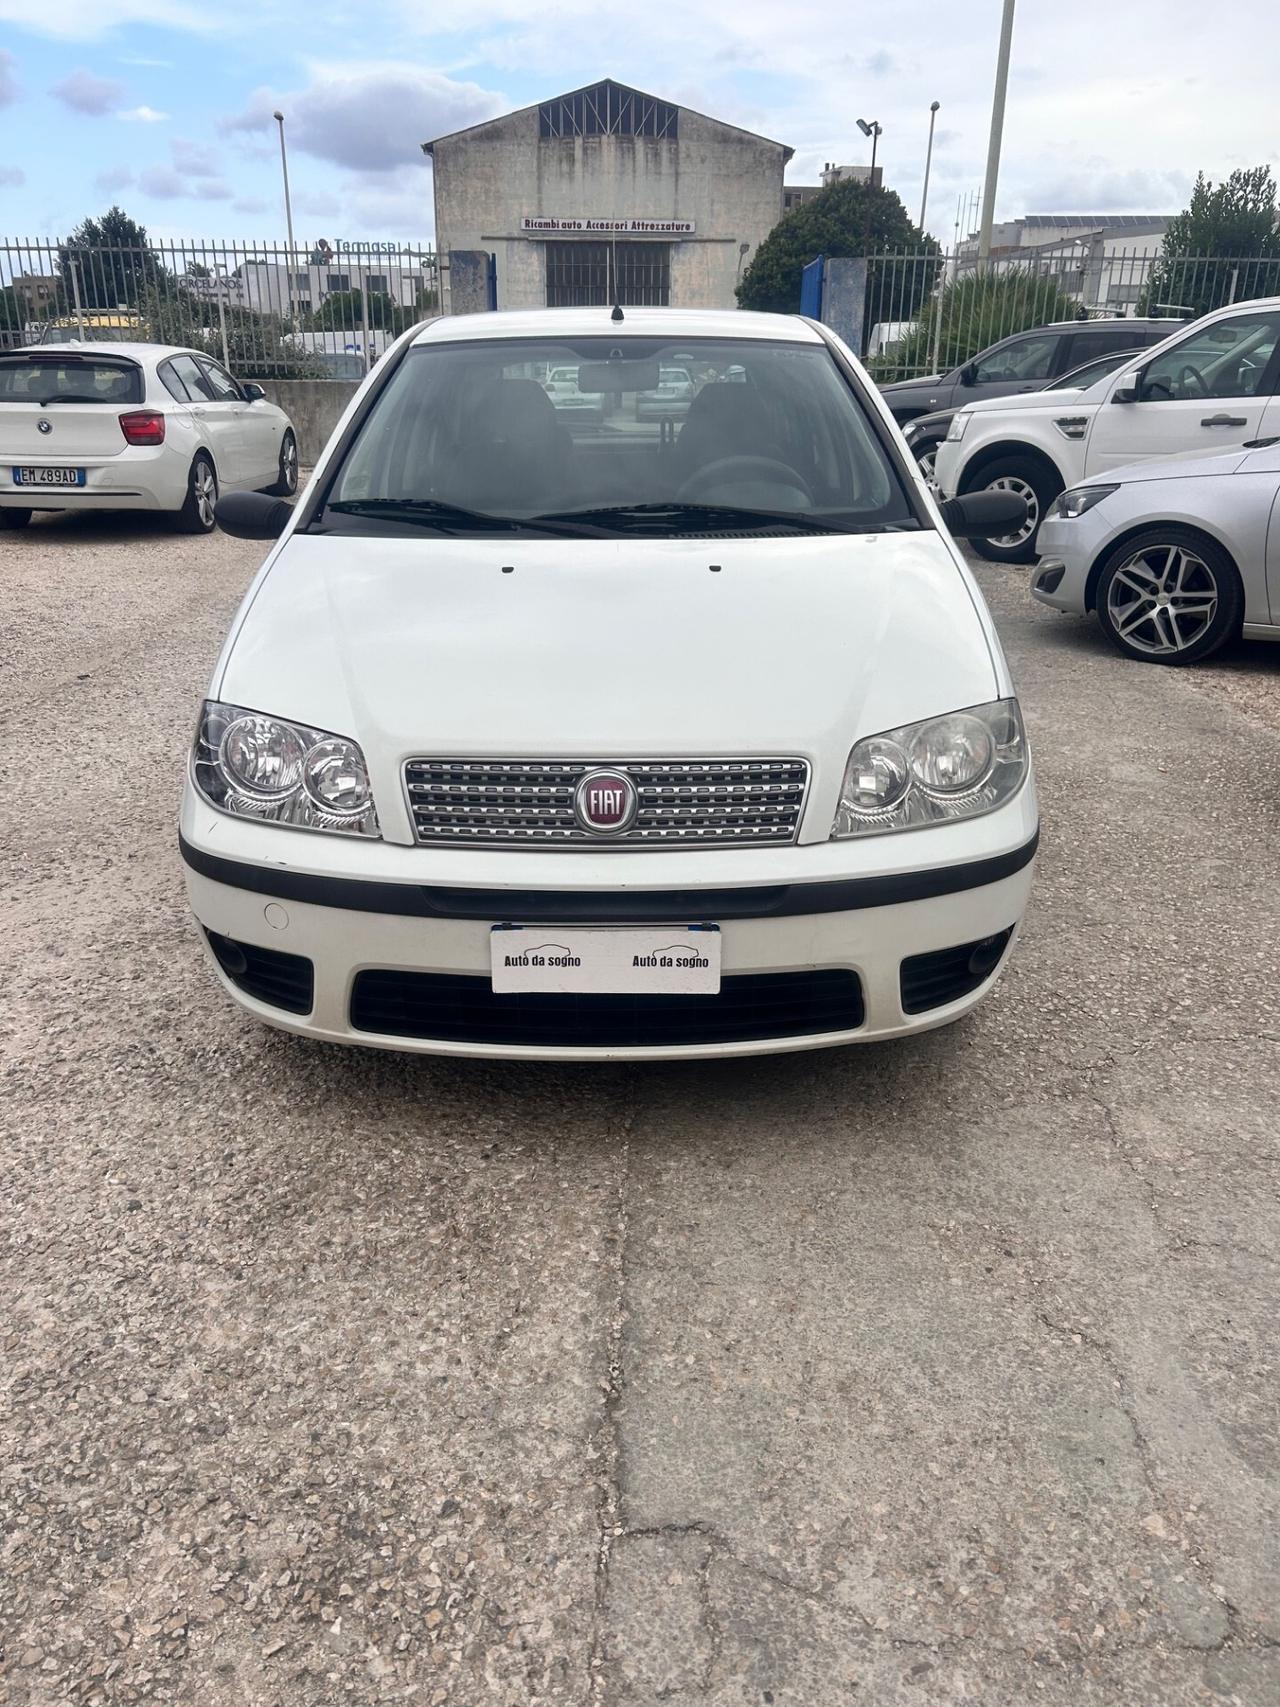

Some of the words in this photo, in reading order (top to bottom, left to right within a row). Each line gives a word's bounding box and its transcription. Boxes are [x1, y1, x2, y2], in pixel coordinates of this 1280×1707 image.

[524, 219, 560, 229] Ricambi
[561, 220, 582, 230] auto
[586, 220, 628, 230] Accessori
[631, 221, 691, 231] Attrezzature
[21, 468, 36, 482] EM
[40, 469, 76, 483] 489AD
[590, 789, 623, 815] FIAT
[504, 955, 528, 967] Auto
[531, 954, 545, 967] da
[548, 955, 581, 968] sogno
[632, 955, 657, 968] Auto
[659, 955, 673, 968] da
[675, 956, 709, 969] sogno
